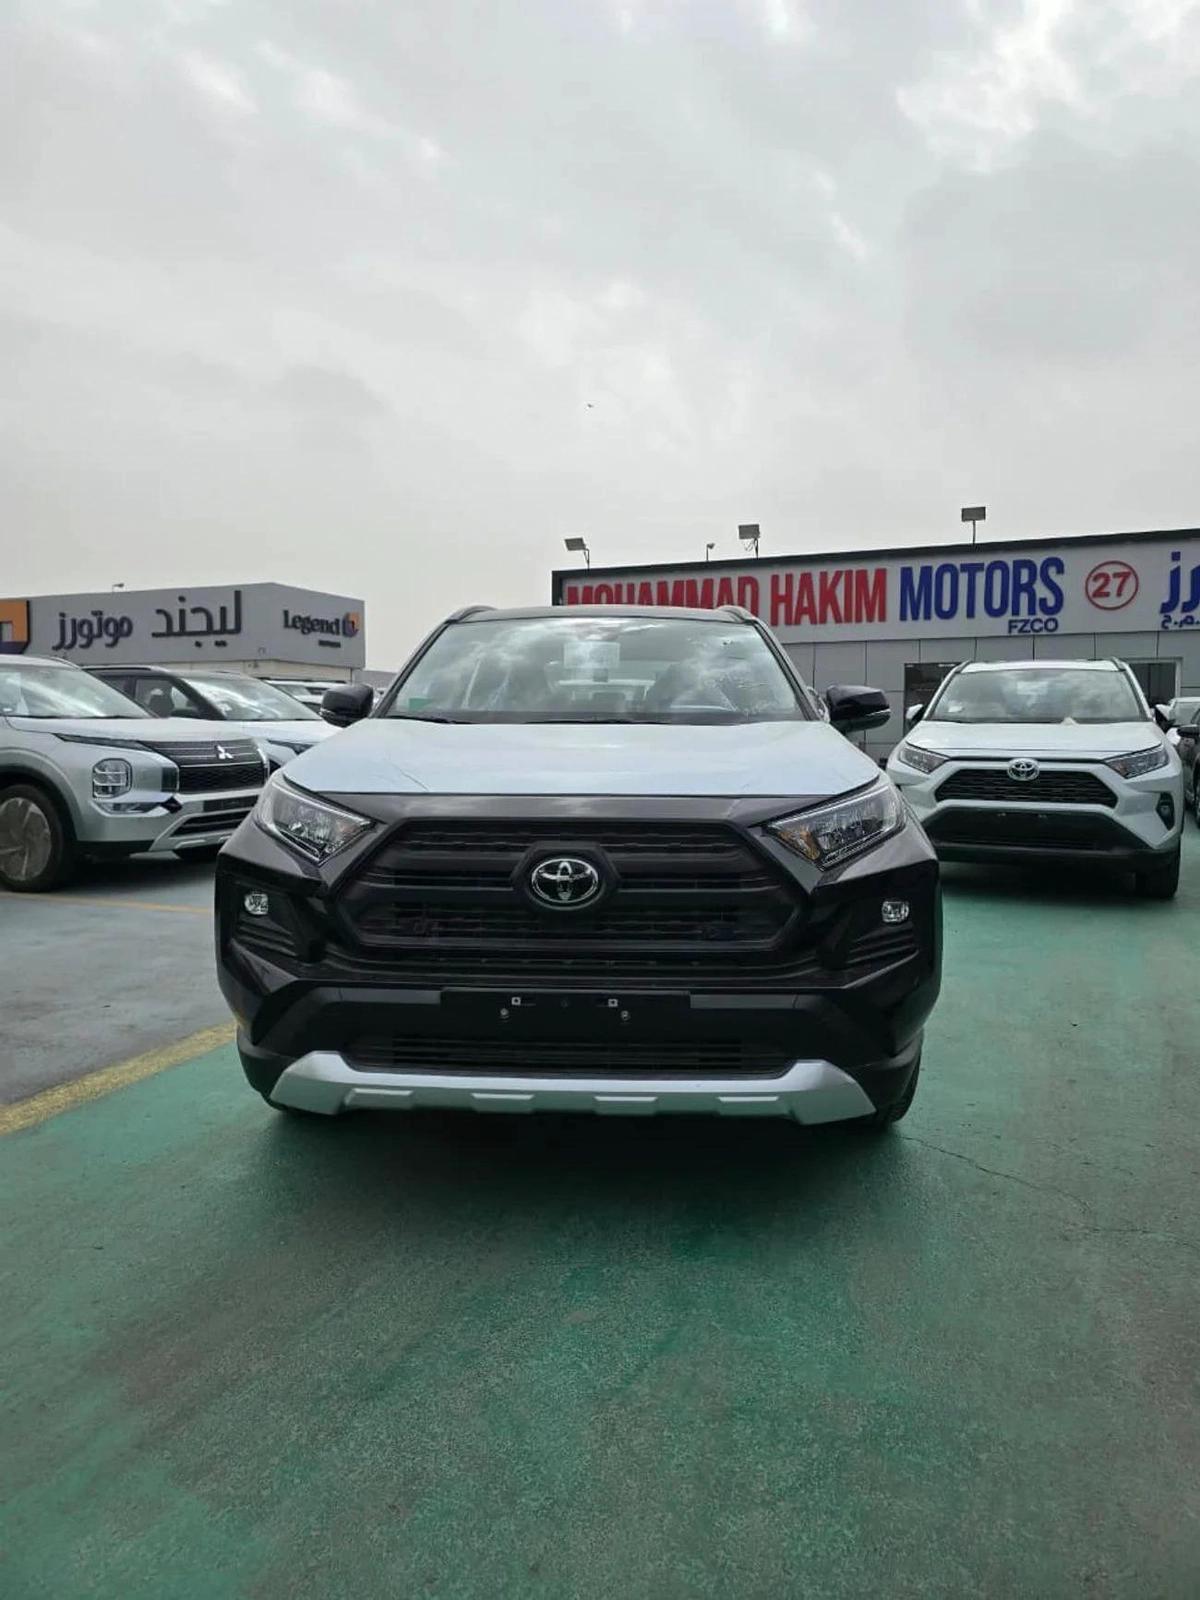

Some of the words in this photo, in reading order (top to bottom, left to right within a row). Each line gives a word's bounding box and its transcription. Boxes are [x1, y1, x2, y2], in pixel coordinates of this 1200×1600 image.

[770, 568, 888, 626] HAKIM
[899, 557, 1065, 622] MOTORS
[1091, 572, 1132, 598] 27
[52, 611, 133, 651] موتورز
[151, 590, 242, 647] ليجند
[283, 609, 340, 636] Legend
[1008, 618, 1059, 634] FZCO
